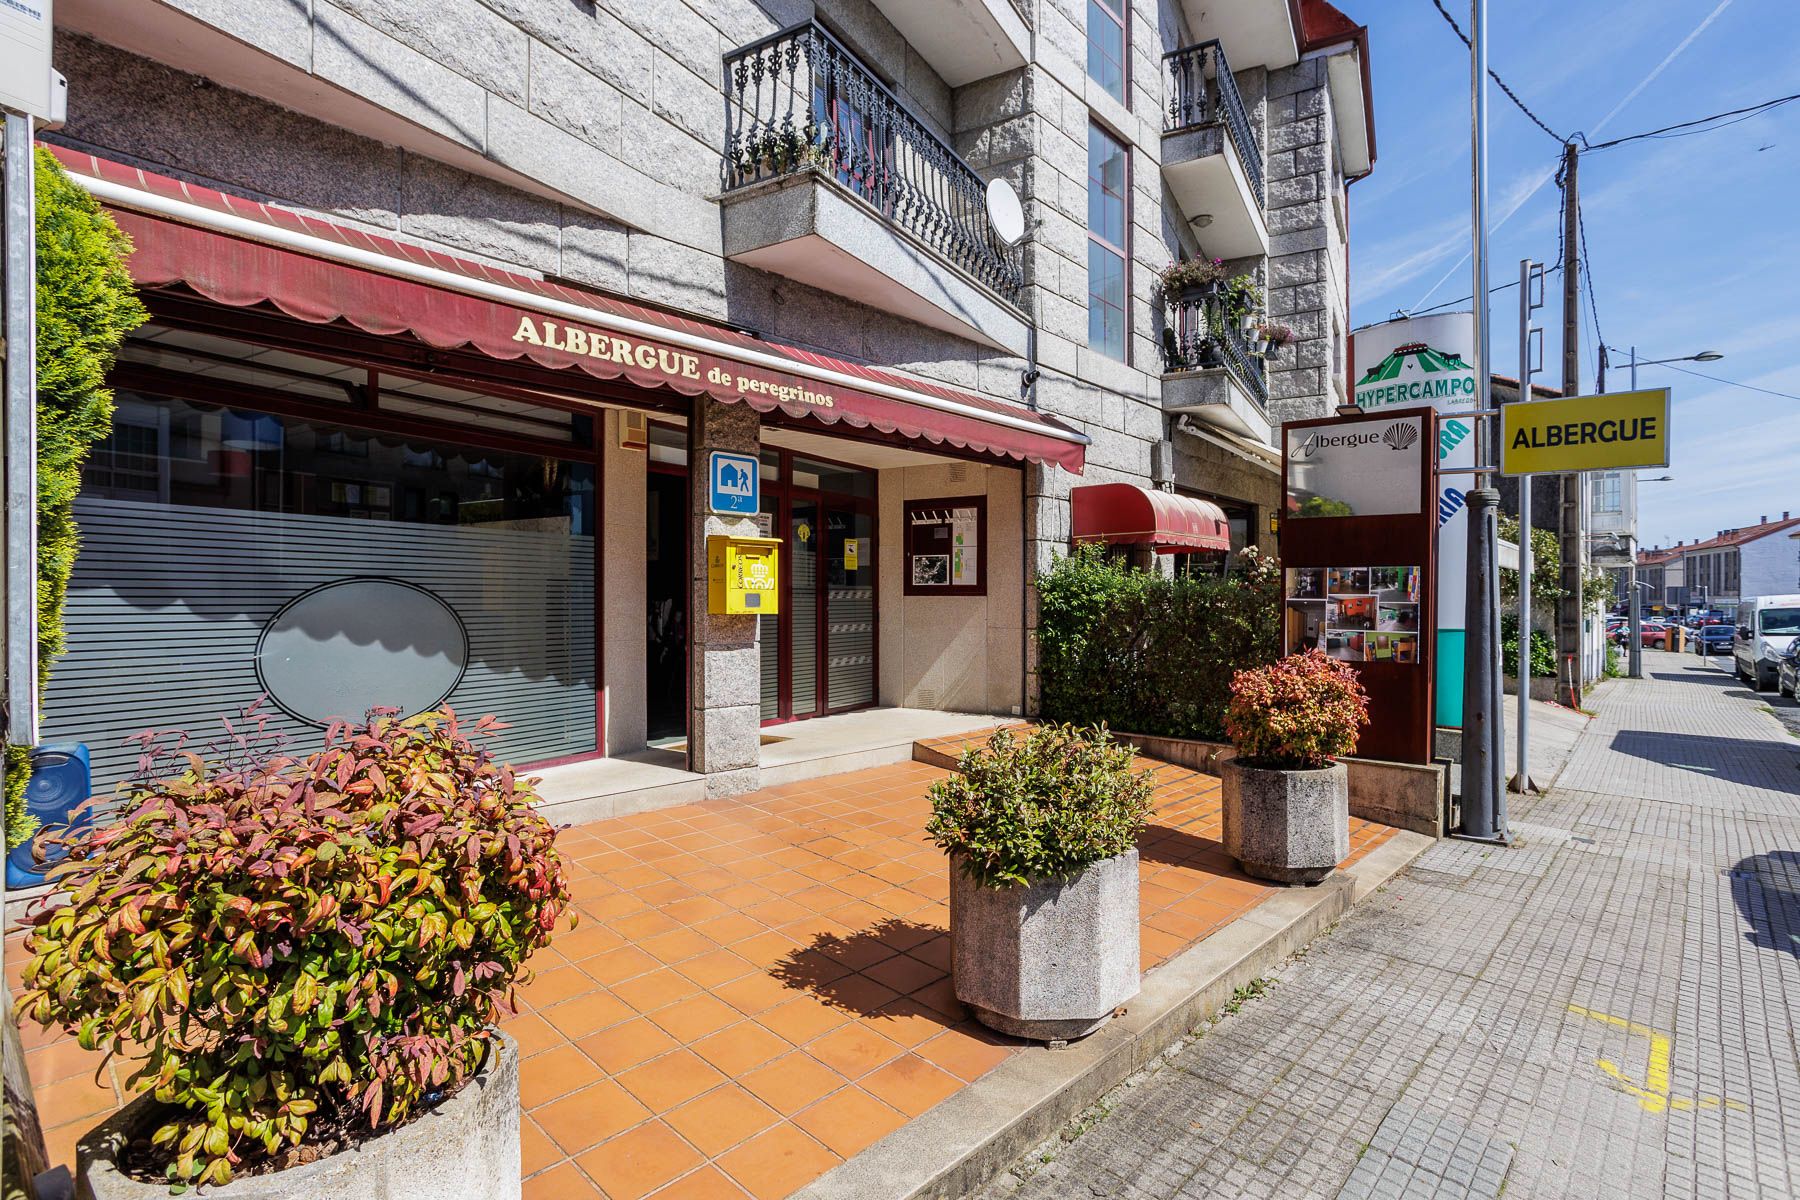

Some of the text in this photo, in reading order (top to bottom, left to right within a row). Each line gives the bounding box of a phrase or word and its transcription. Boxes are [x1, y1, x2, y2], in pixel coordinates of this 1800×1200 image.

[512, 316, 834, 408] ALBERGUE de peregrinos
[1356, 376, 1475, 408] HYPERCAMPO
[1291, 431, 1380, 458] Albergue
[1512, 417, 1657, 449] ALBERGUE
